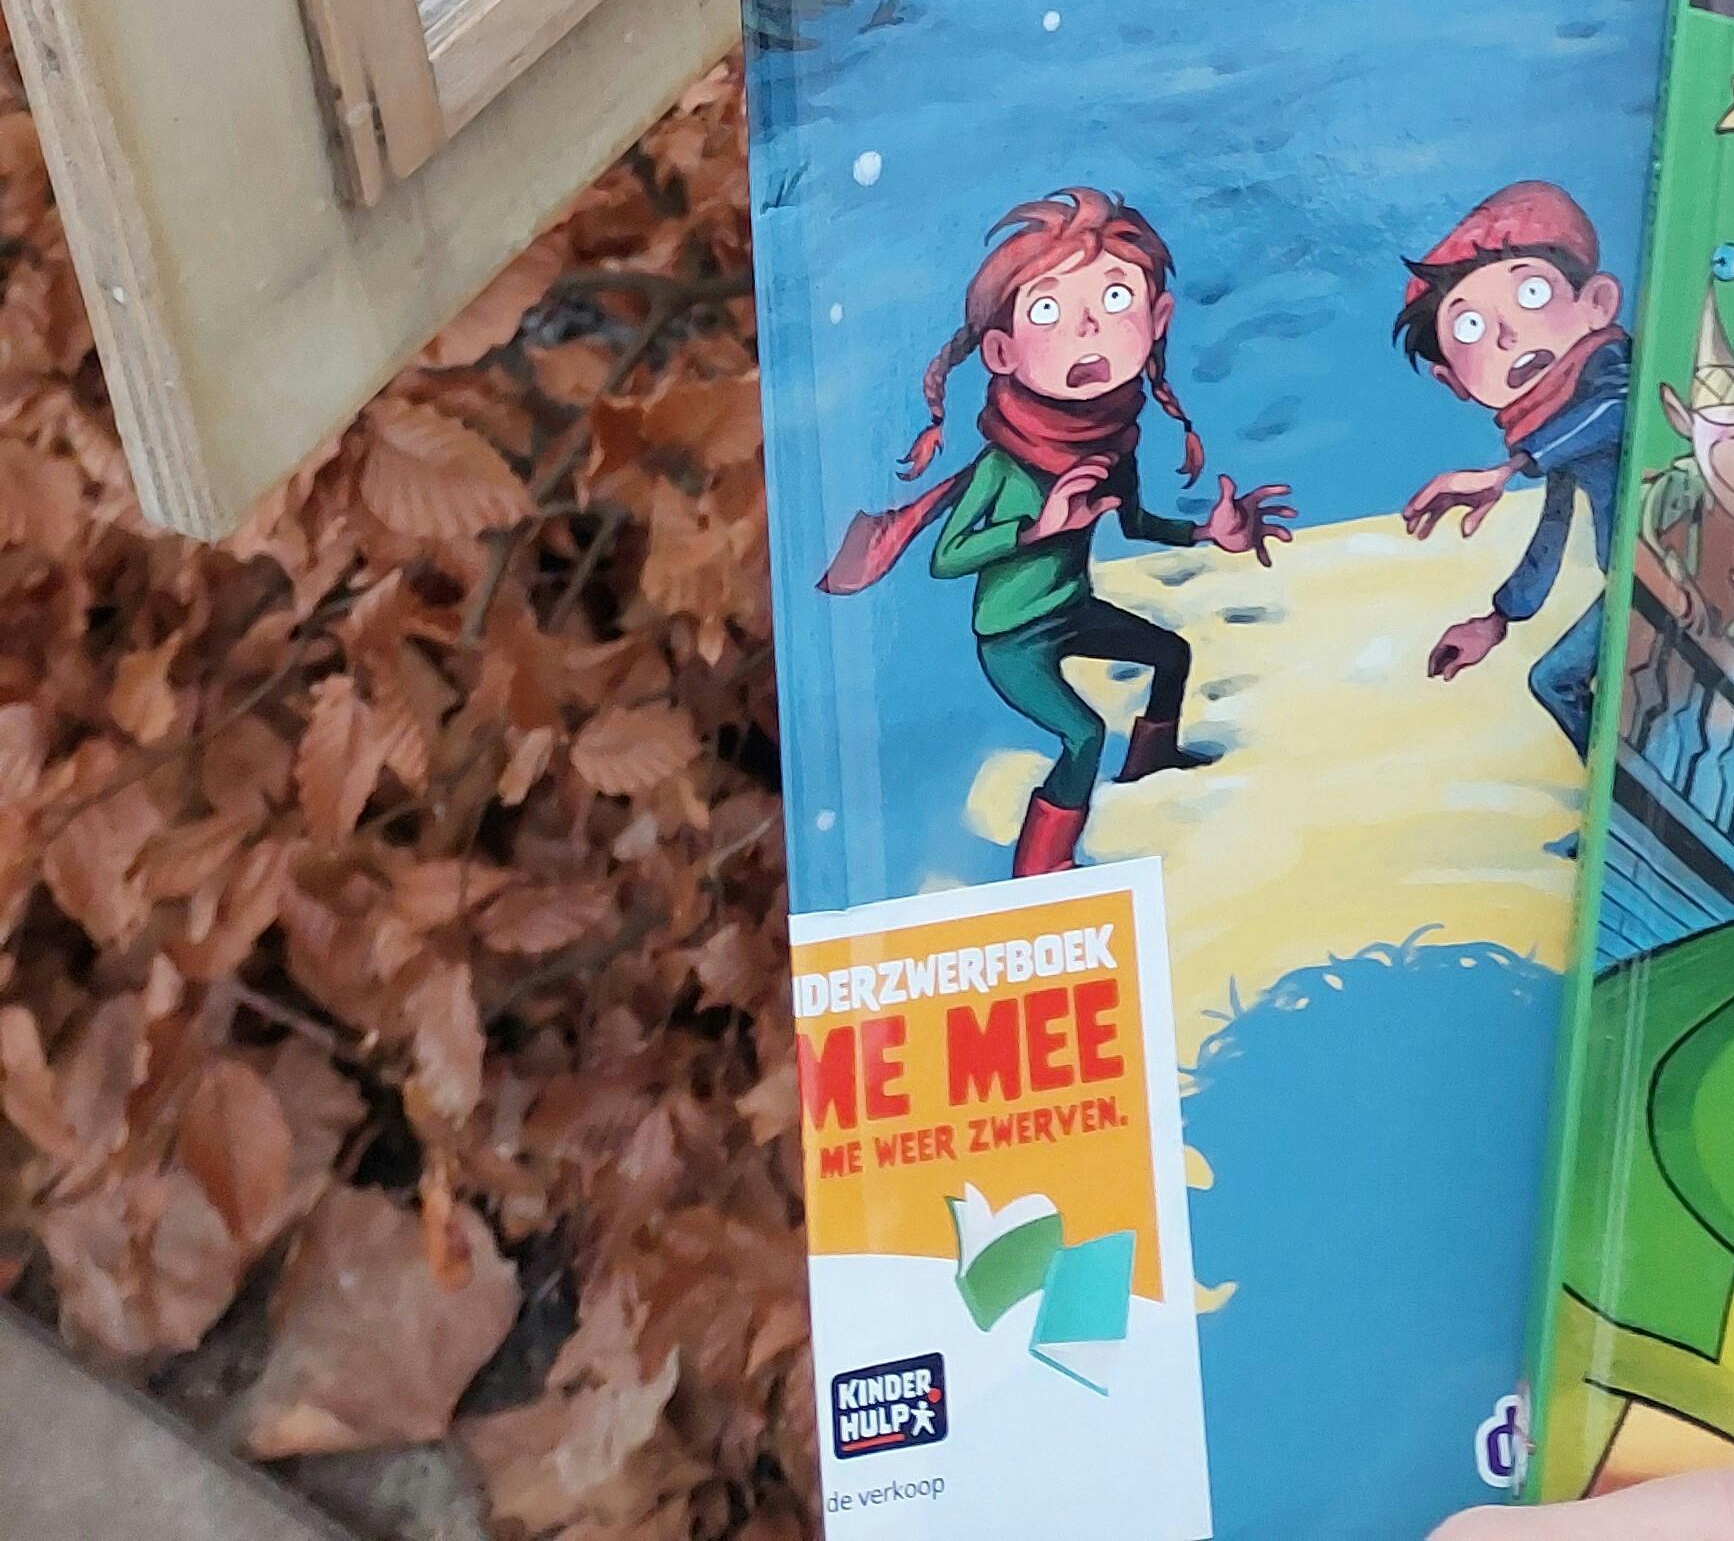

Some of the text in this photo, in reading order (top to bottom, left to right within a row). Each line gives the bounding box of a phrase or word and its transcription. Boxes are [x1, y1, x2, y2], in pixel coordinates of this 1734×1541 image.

[795, 977, 1125, 1131] ME MEE
[819, 1095, 1129, 1179] ME WEER ZWERVEN.
[837, 1365, 933, 1411] KINDER
[839, 1401, 910, 1444] HULP
[826, 1473, 946, 1514] de verkoop
